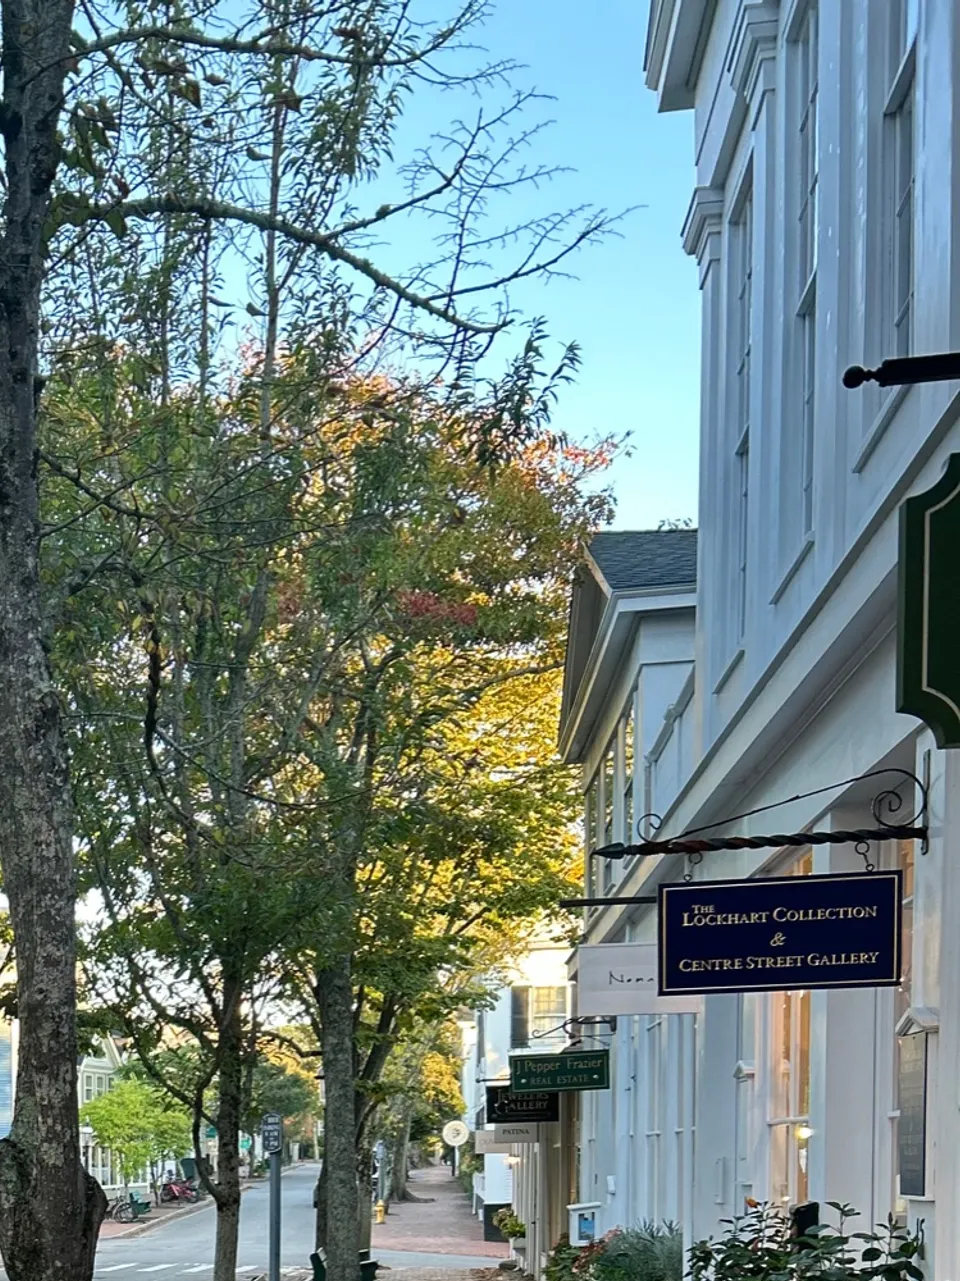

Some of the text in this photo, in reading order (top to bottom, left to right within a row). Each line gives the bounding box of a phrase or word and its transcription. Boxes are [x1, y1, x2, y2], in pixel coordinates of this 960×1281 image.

[682, 905, 878, 927] LOCKHART COLLECTION
[692, 905, 715, 914] THE
[770, 932, 787, 947] &
[679, 952, 880, 972] CENTRE STREET GALLERY
[524, 1060, 560, 1074] Pepper
[566, 1058, 602, 1070] Frazier
[530, 1075, 589, 1086] REAL ESTATE
[502, 1127, 531, 1136] PATINA
